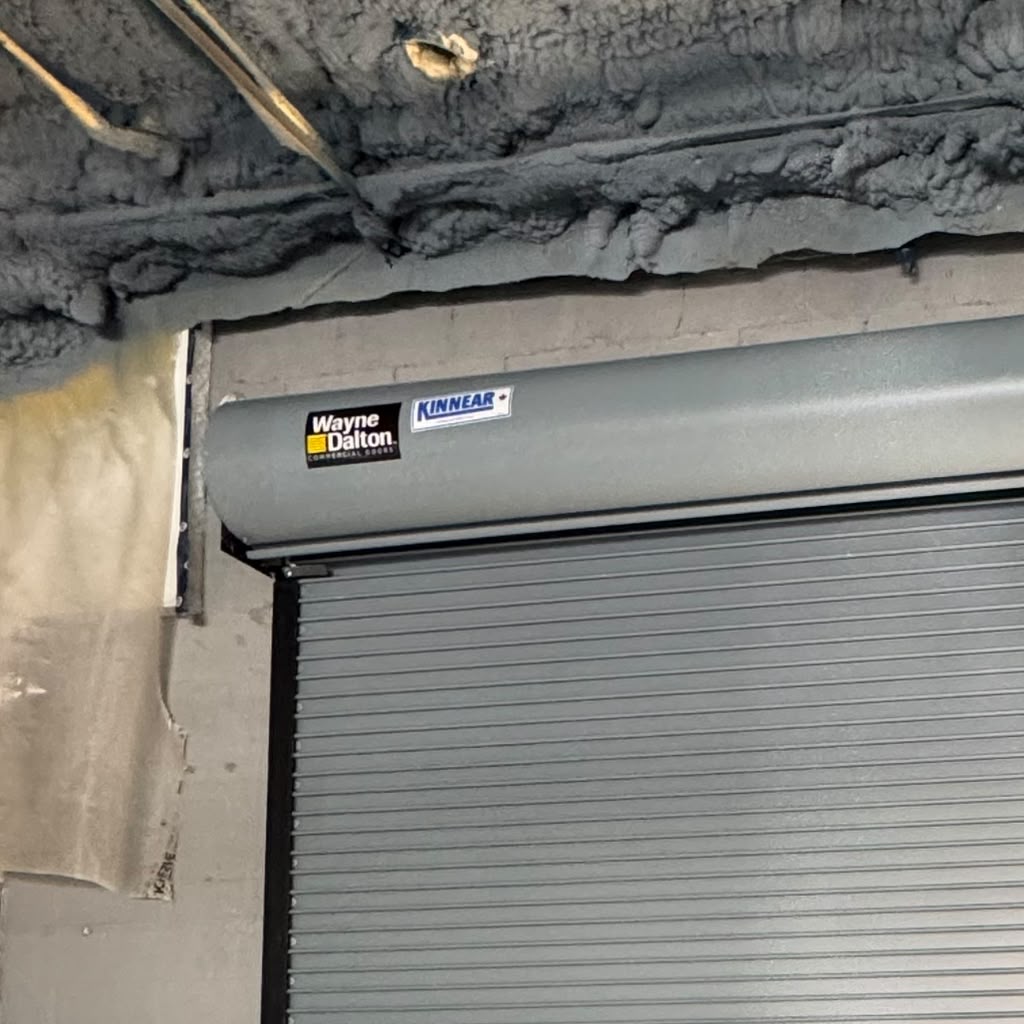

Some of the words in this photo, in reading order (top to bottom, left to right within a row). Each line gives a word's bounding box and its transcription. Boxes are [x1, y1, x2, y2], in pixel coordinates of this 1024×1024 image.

[417, 392, 495, 421] KINNEAR
[312, 413, 380, 434] Wayne
[328, 430, 393, 452] Dalton
[308, 451, 362, 462] COMMERCIAL
[364, 447, 394, 456] DOORS
